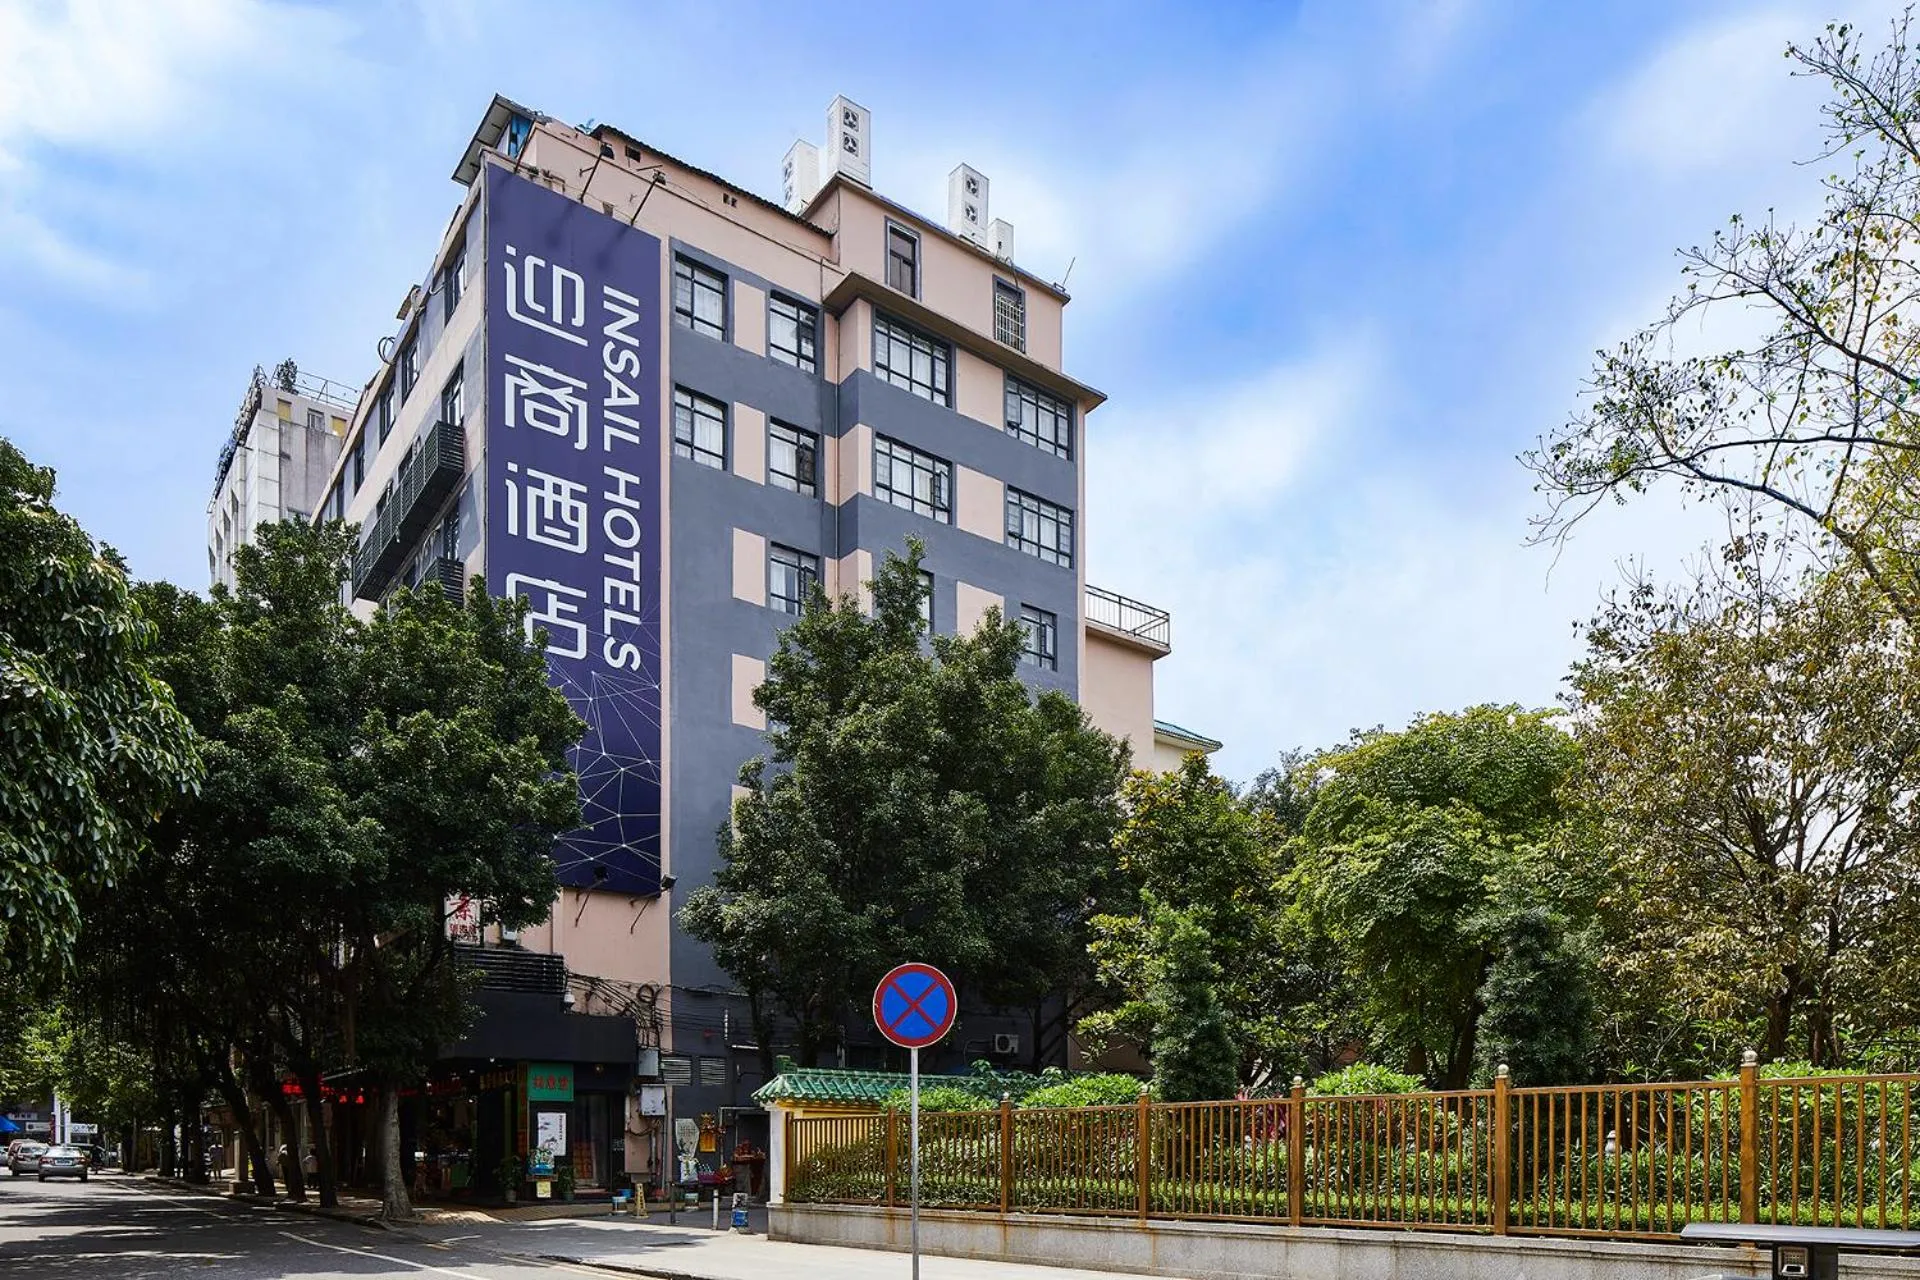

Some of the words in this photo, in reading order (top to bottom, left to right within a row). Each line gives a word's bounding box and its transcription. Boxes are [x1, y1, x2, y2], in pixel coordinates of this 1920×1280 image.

[504, 244, 588, 660] 迎商酒店
[602, 285, 640, 452] INSAIL
[602, 465, 641, 671] HOTELS
